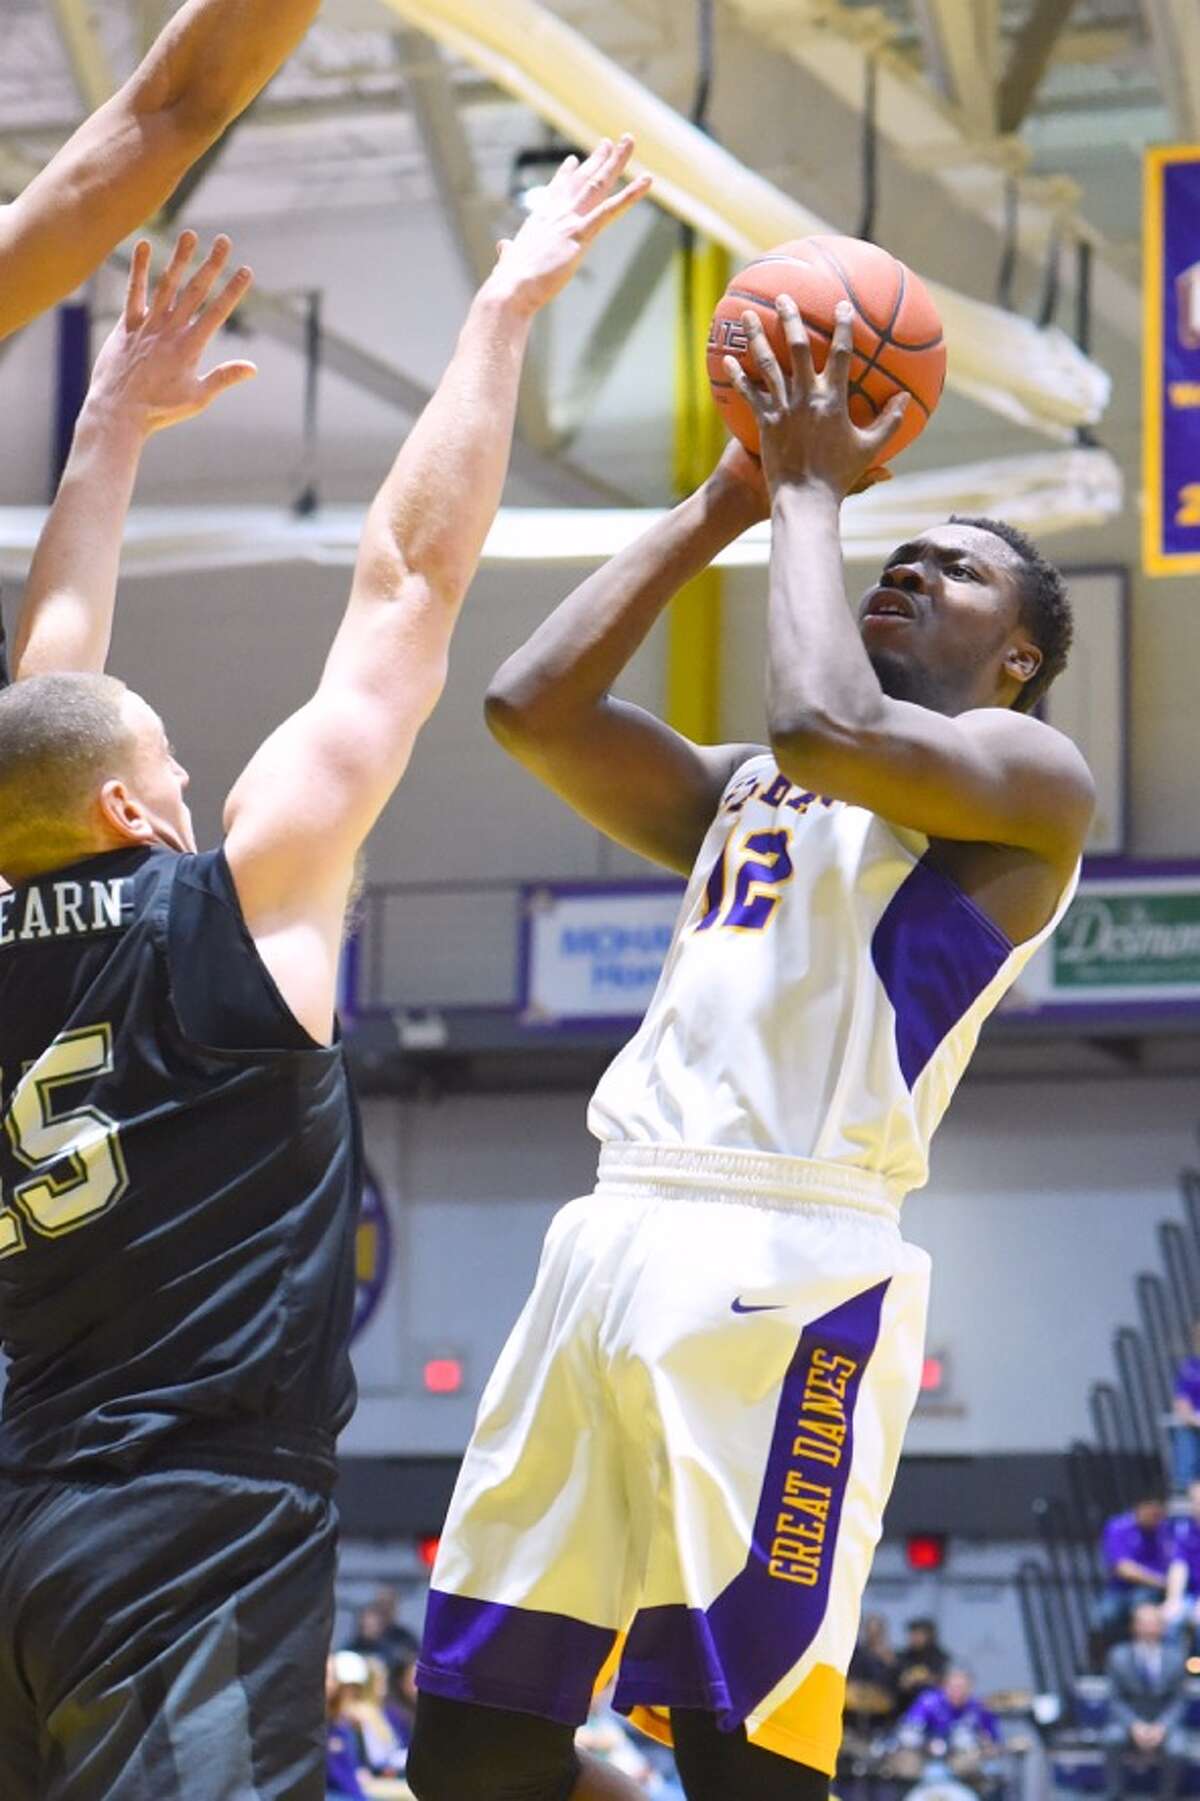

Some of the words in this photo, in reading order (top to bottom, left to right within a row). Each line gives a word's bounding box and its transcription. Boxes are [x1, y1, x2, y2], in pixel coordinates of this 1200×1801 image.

[694, 822, 794, 935] 12
[793, 1348, 857, 1468] DANES
[768, 1470, 832, 1587] GREAT
